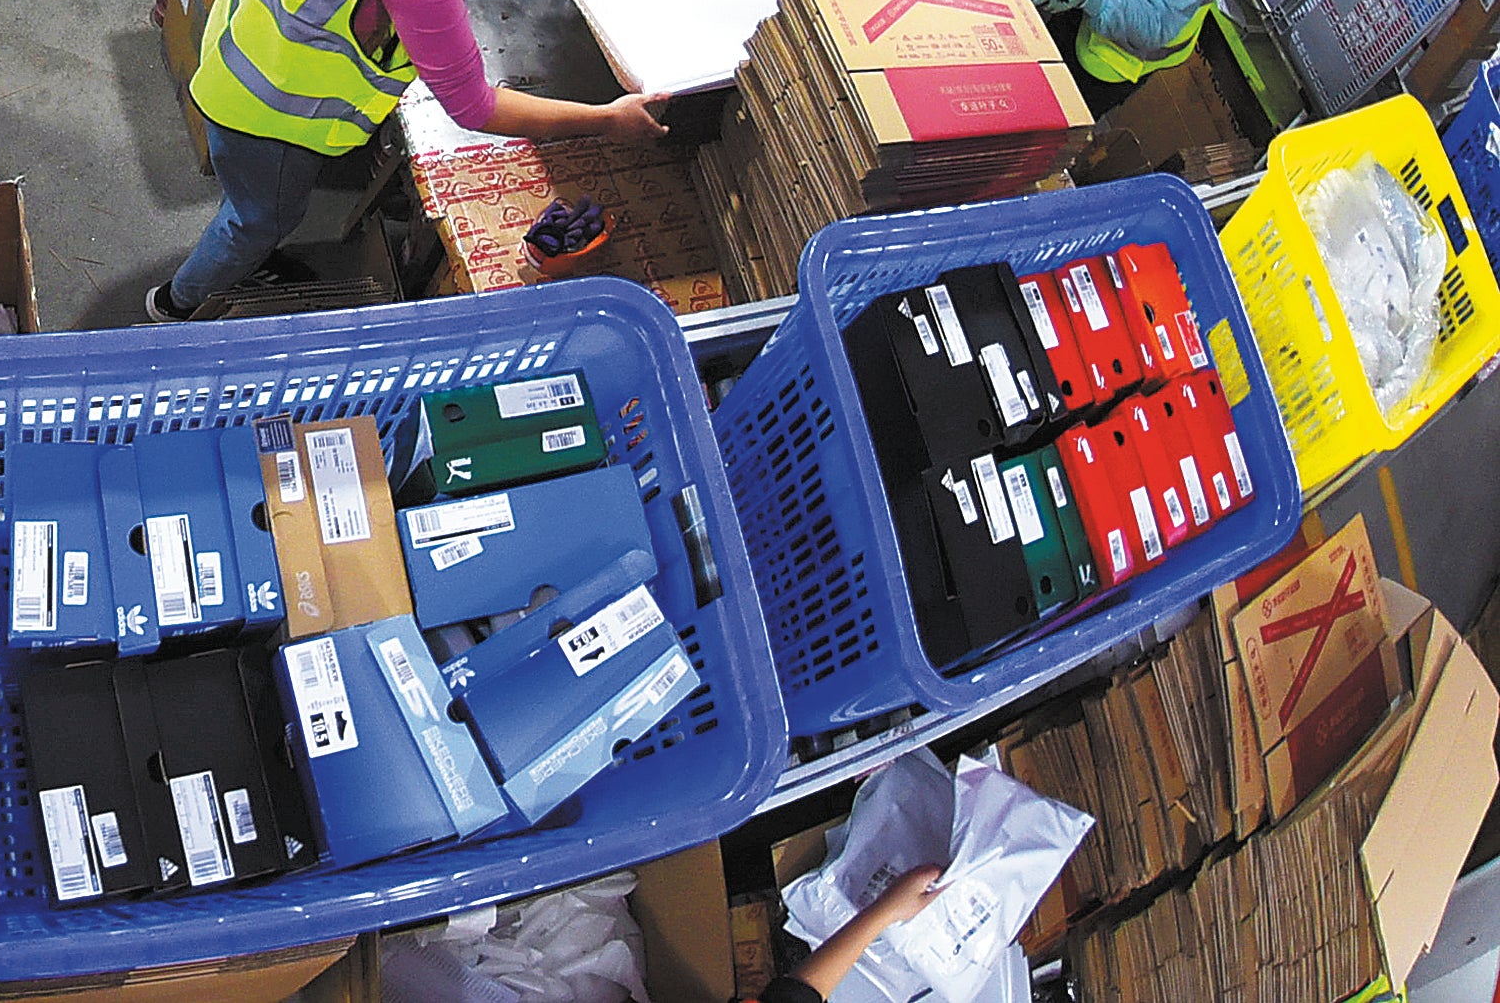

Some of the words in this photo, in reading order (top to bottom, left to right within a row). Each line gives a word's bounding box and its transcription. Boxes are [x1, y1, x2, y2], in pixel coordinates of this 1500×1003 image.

[248, 583, 258, 612] adidas
[117, 606, 126, 636] adidas
[573, 624, 596, 646] 10.5
[312, 717, 328, 744] 10.5
[427, 726, 473, 808] SKECHERS
[535, 724, 607, 783] SKECHERS
[421, 728, 463, 813] PERFORMANCE
